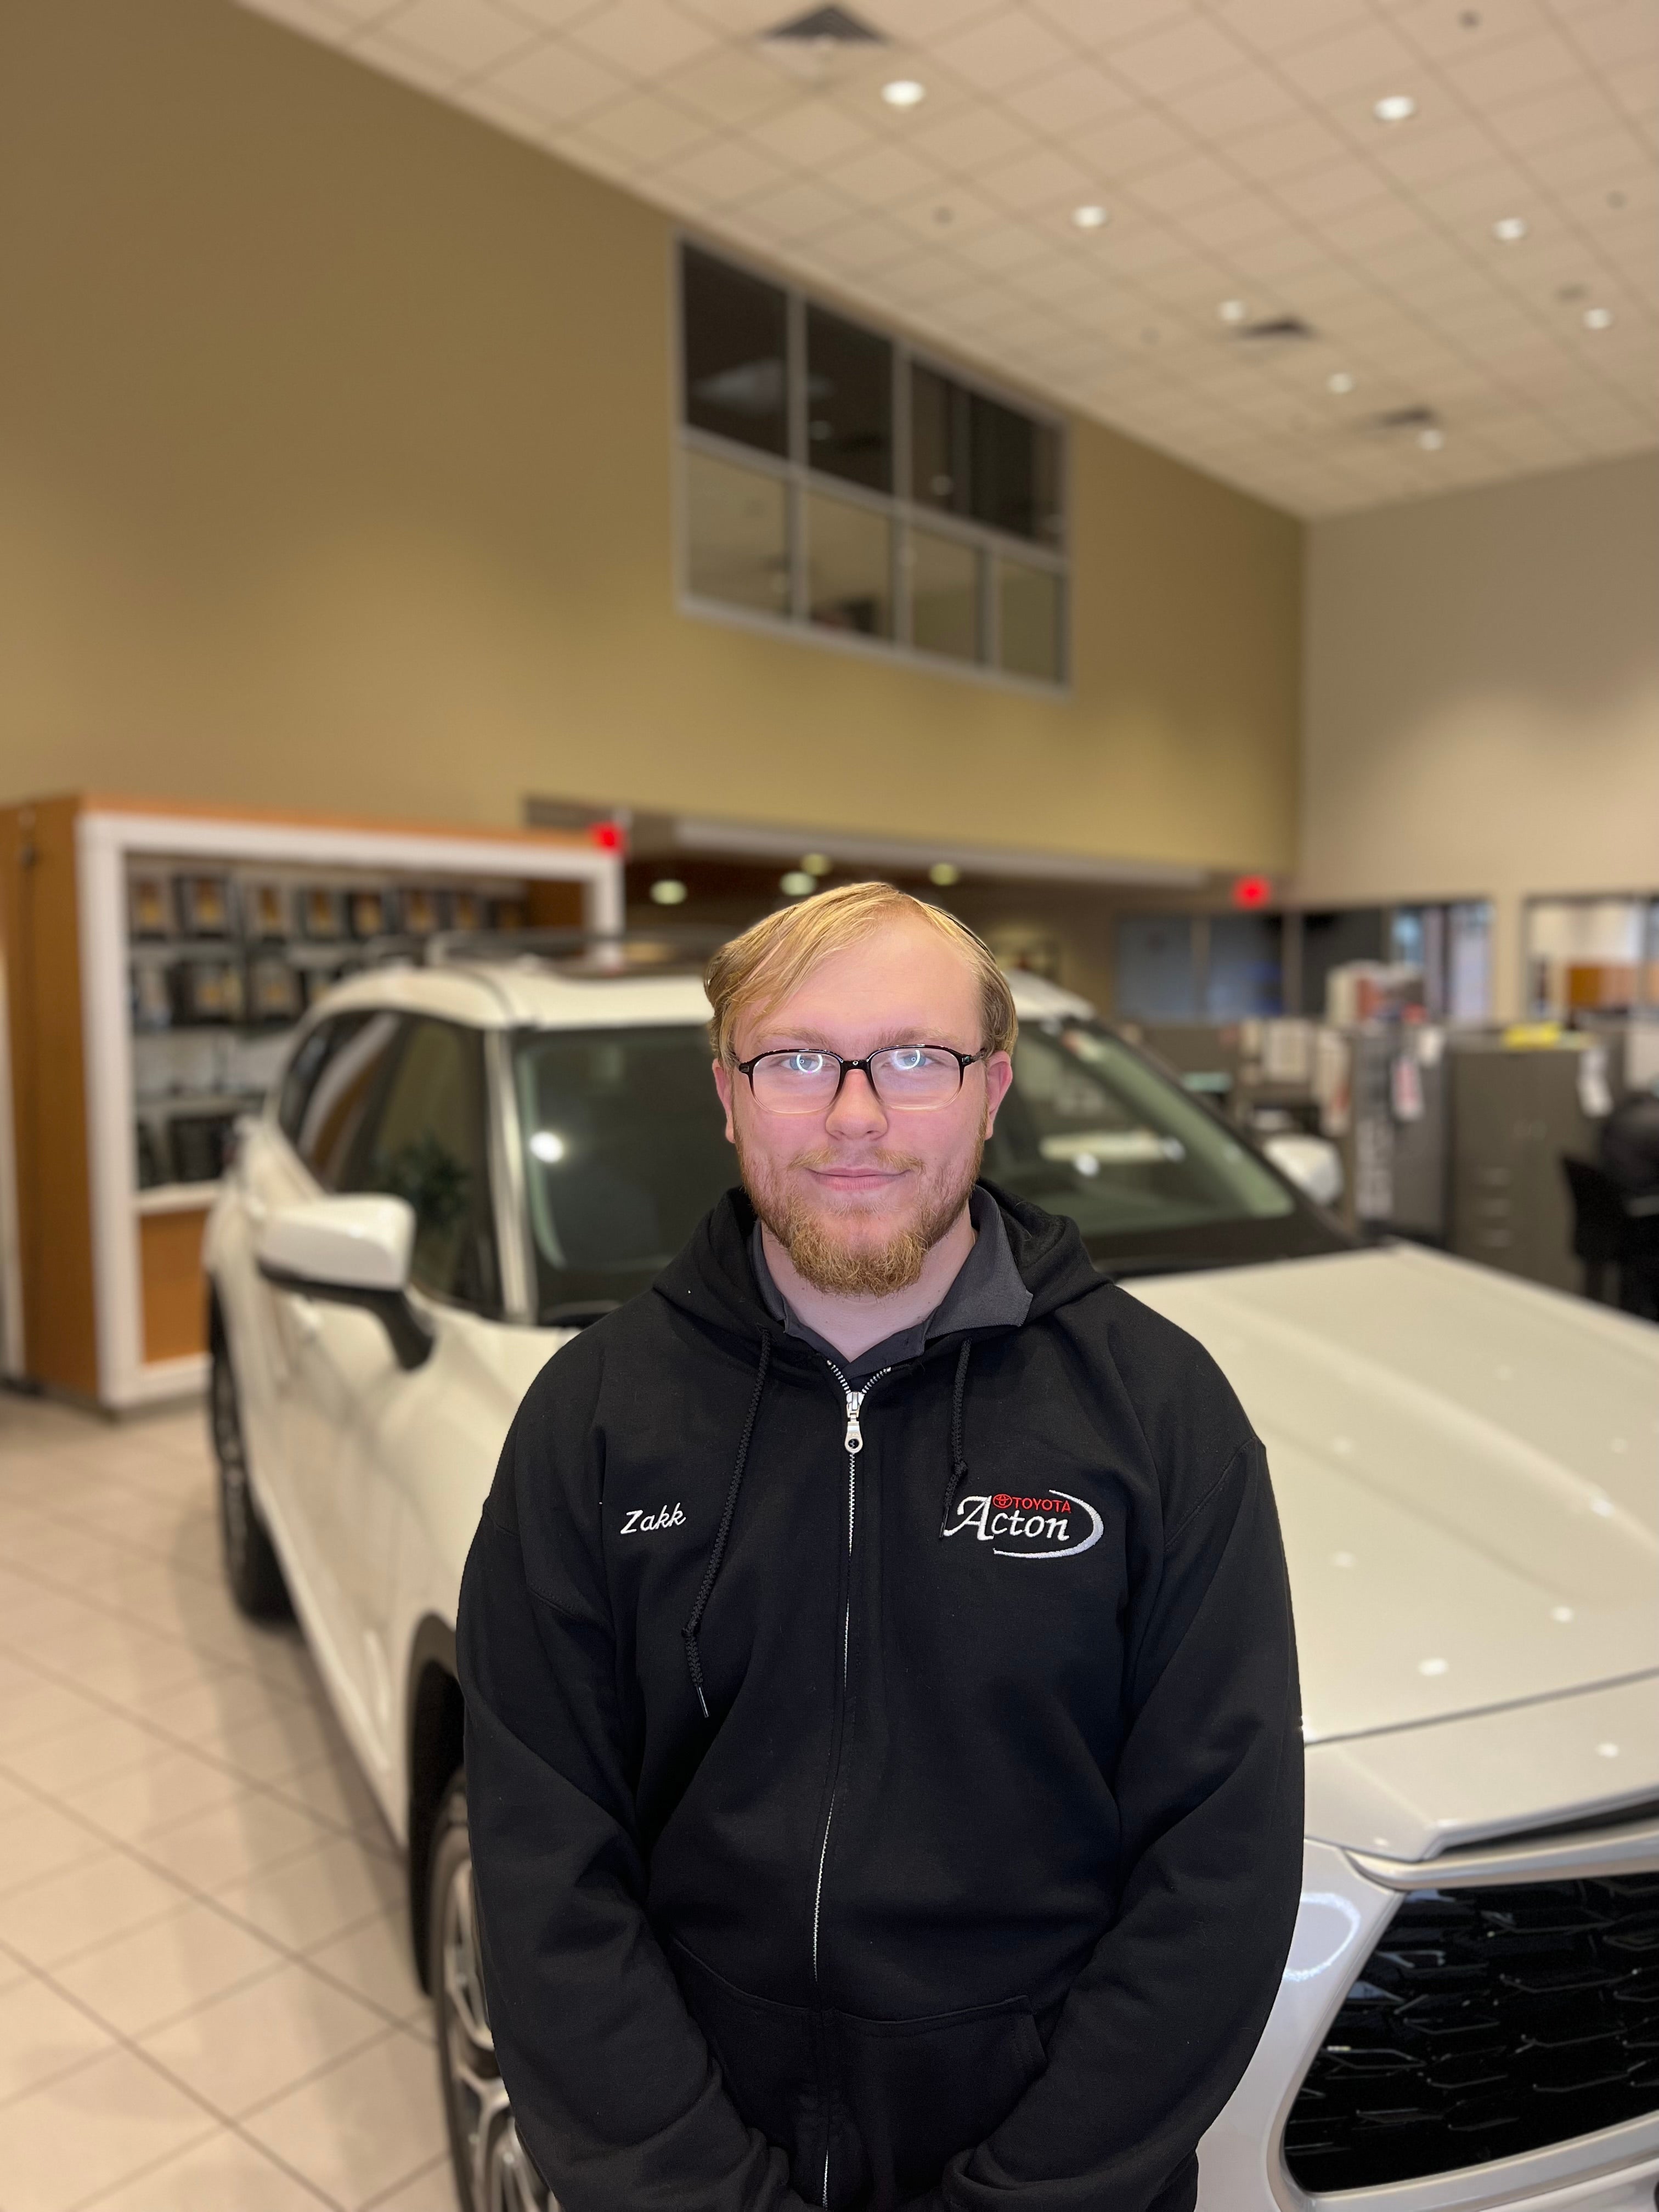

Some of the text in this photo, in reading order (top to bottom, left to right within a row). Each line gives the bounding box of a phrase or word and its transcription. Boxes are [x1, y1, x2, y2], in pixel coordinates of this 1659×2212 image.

[620, 1502, 686, 1534] Zakk
[943, 1496, 1070, 1541] Acton
[1012, 1497, 1071, 1514] TOYOTA
